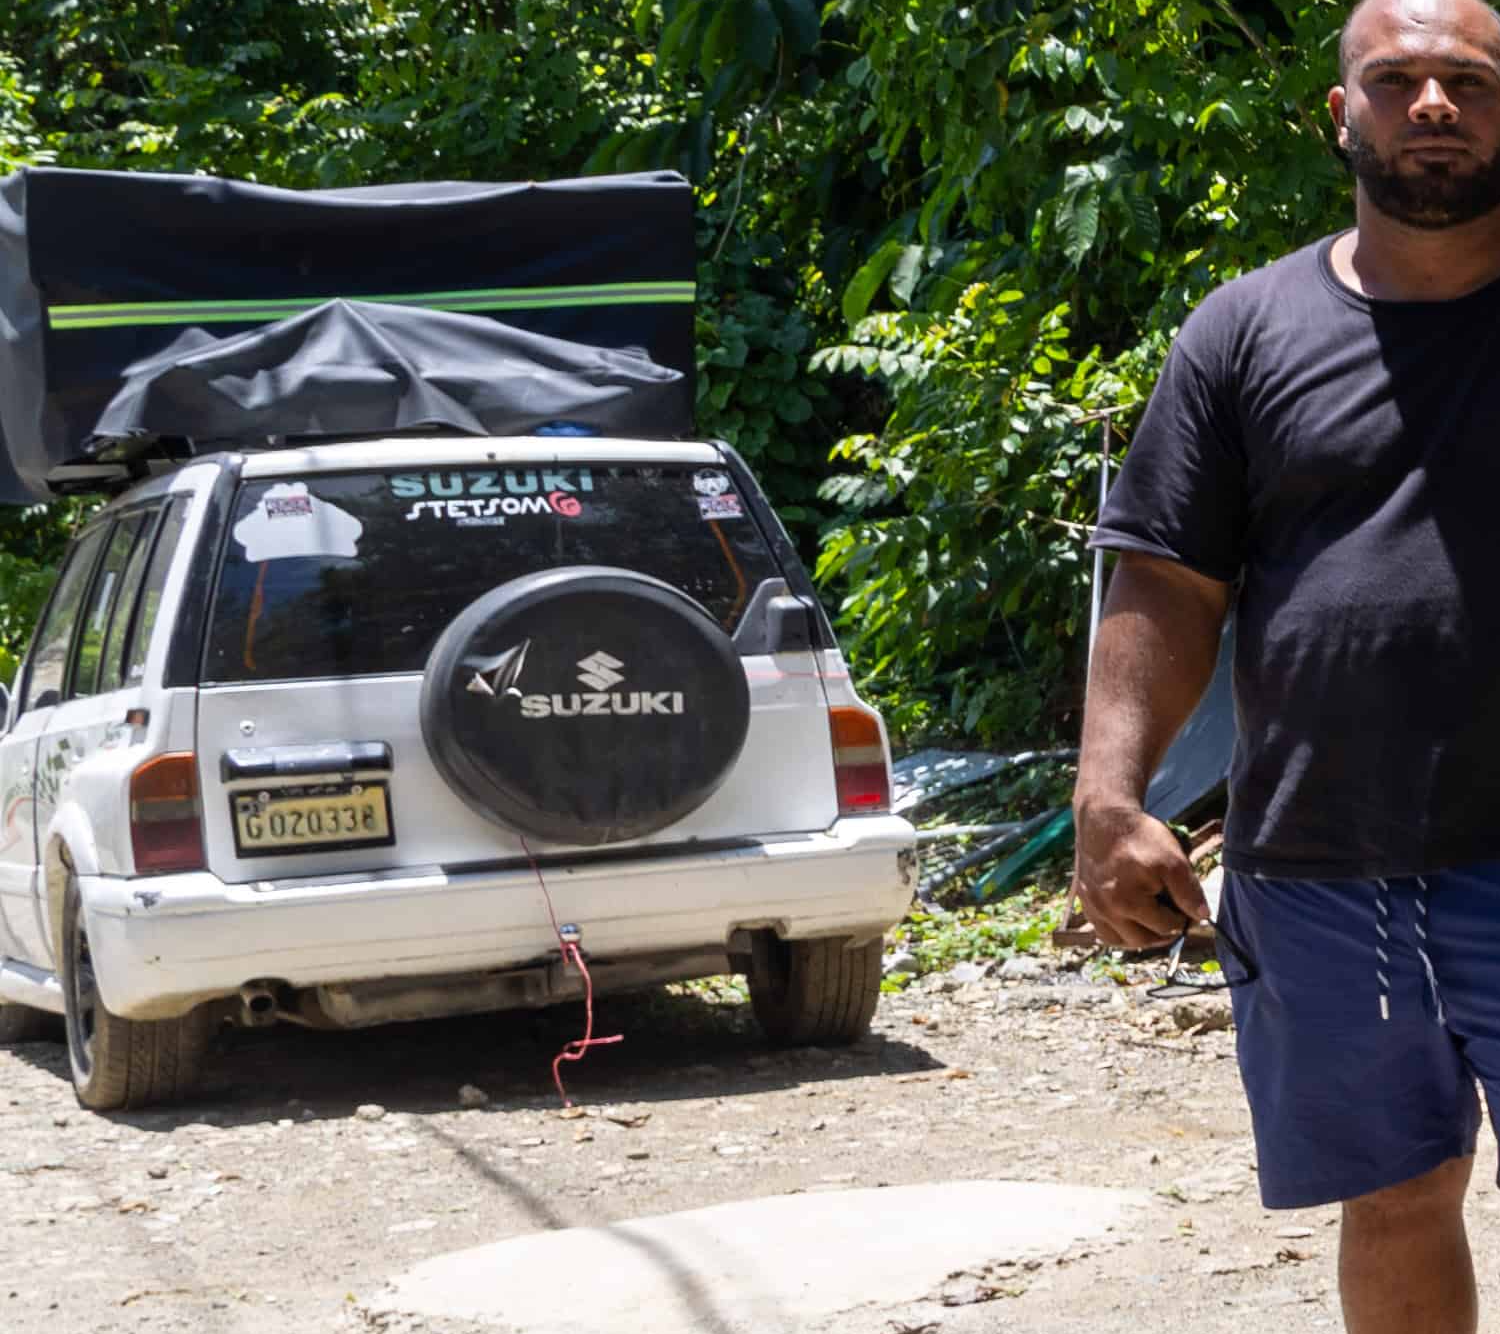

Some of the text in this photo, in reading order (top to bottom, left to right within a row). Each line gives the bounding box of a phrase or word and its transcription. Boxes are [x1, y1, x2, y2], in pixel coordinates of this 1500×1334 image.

[391, 468, 593, 497] SUZUKI
[405, 496, 552, 521] STETSOM
[519, 691, 684, 718] SUZUKI
